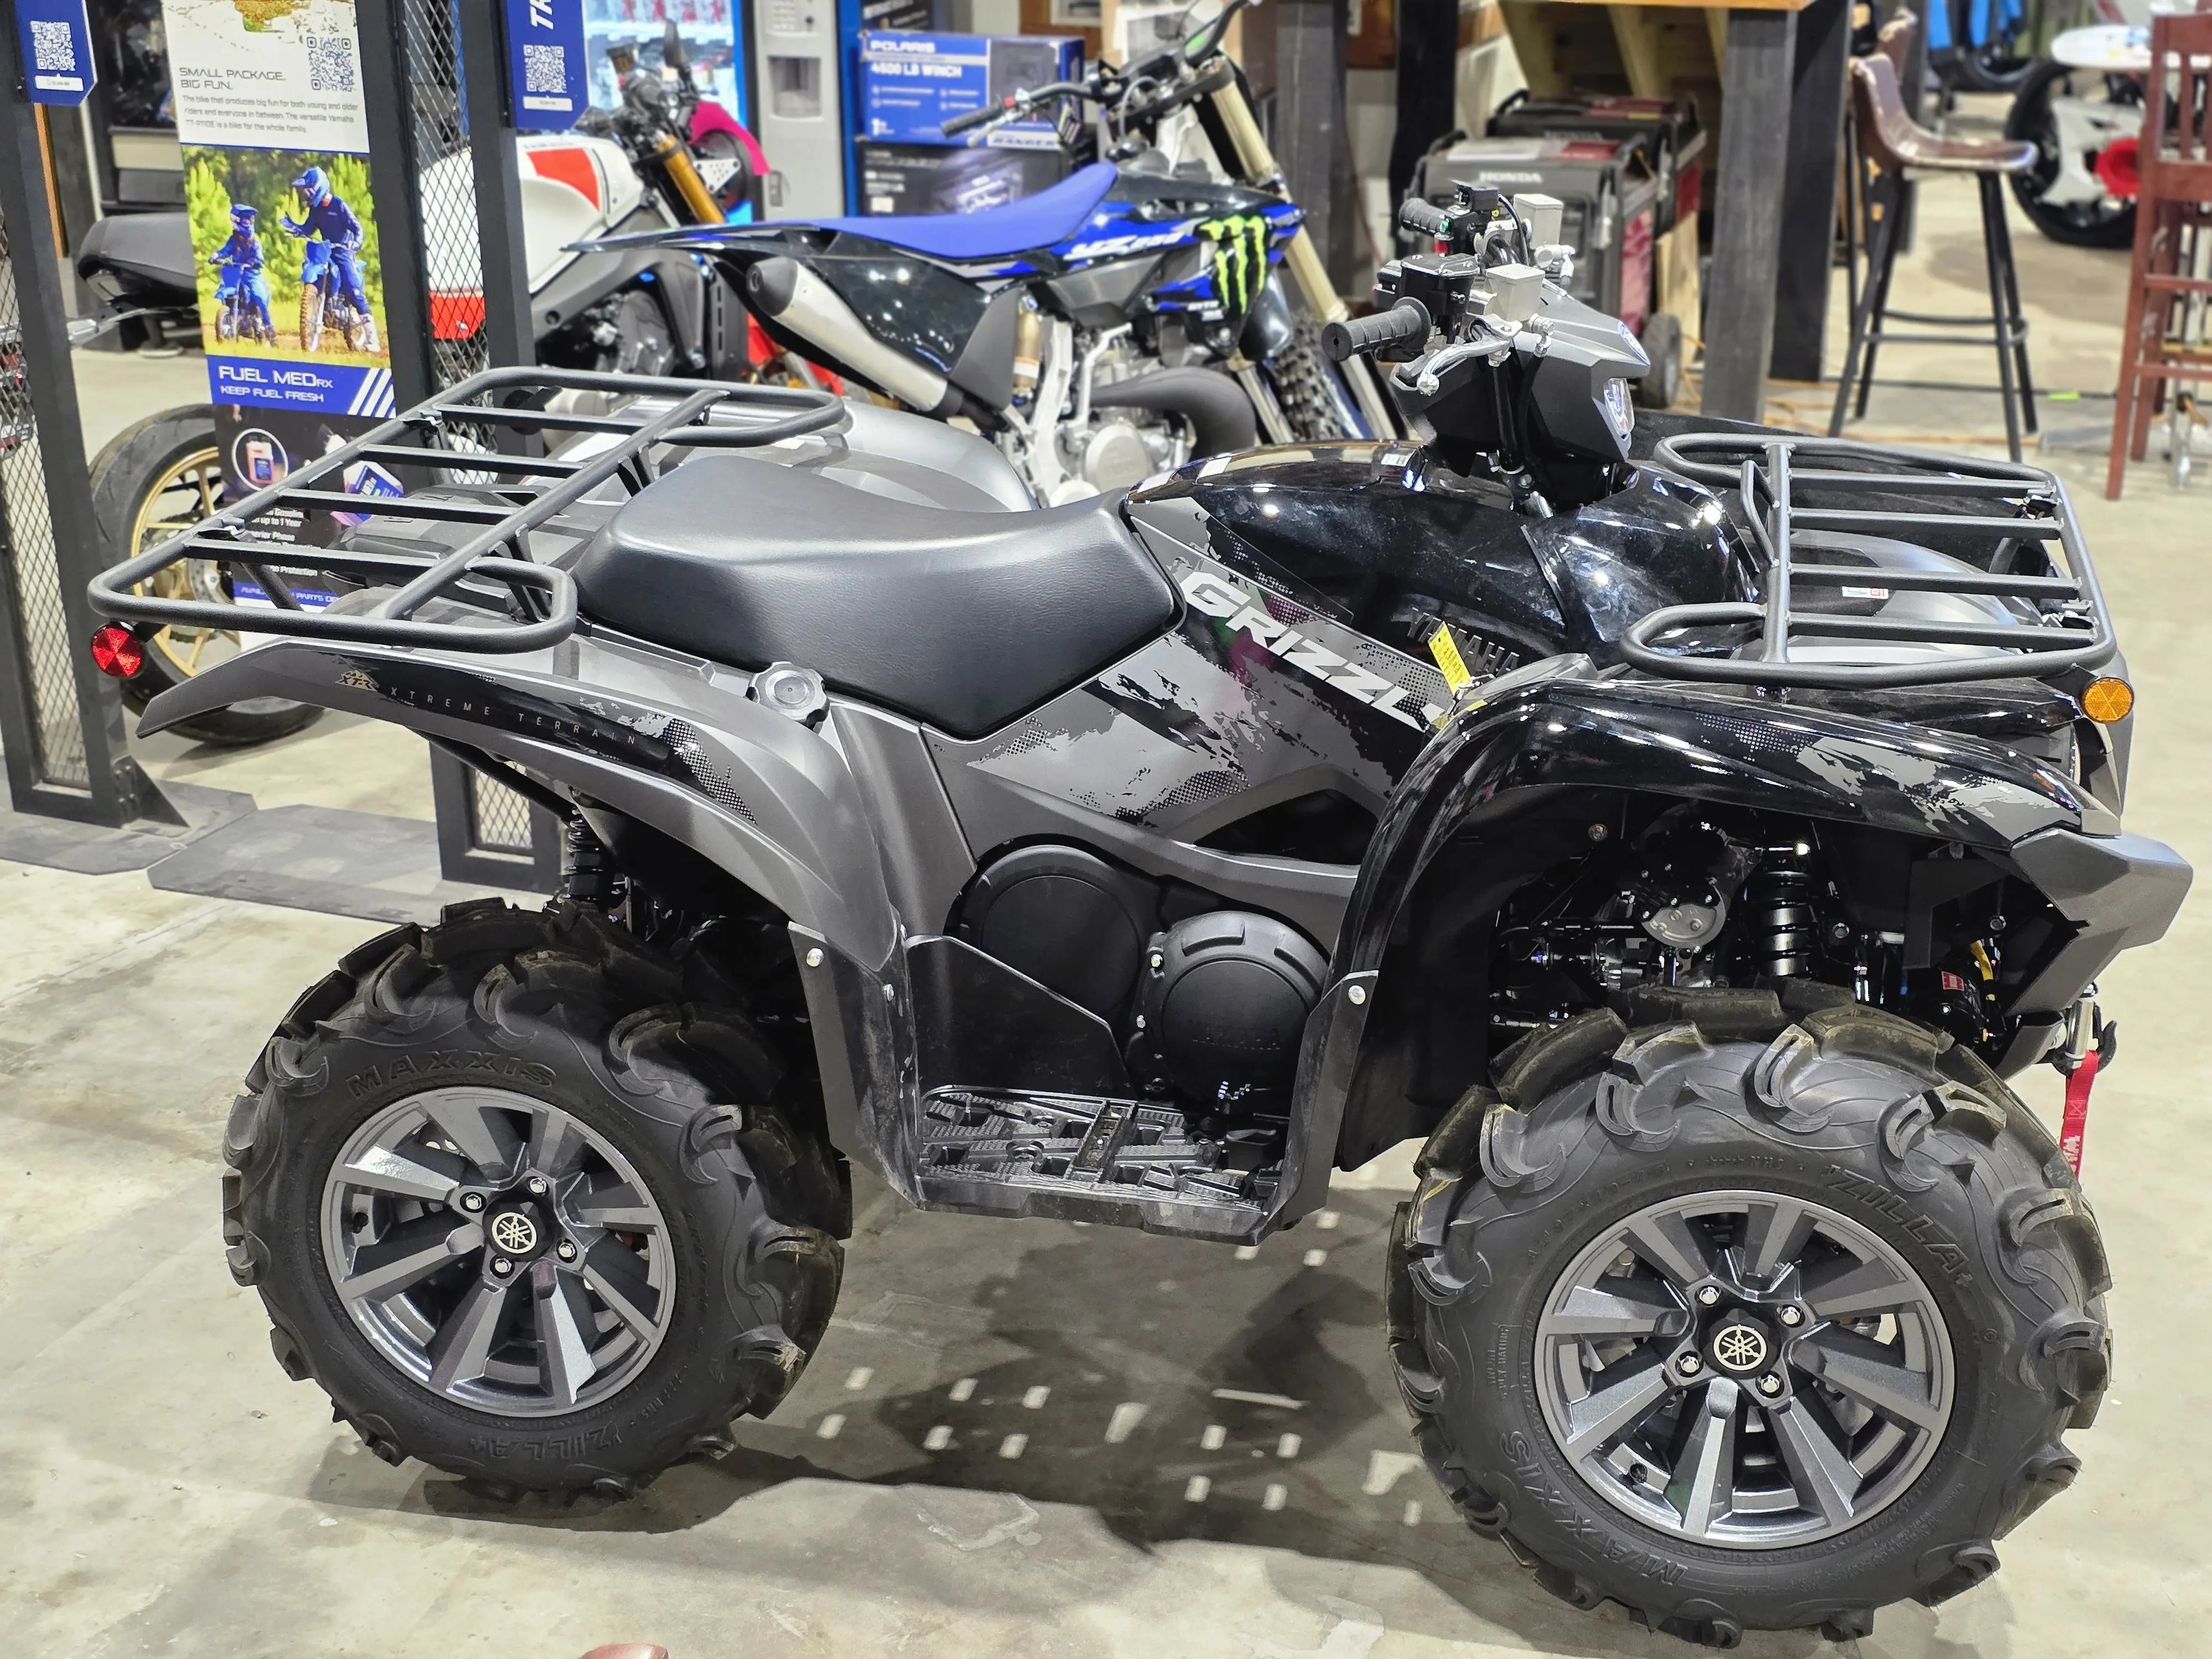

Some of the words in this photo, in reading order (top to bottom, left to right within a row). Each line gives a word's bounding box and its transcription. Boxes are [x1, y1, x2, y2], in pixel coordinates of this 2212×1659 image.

[870, 40, 936, 53] POLARIS
[179, 67, 223, 77] SMALL
[226, 69, 286, 81] PACKAGE.
[904, 64, 920, 77] LB
[922, 65, 962, 78] WINCH
[180, 79, 201, 88] BIG
[204, 80, 233, 90] FUN.
[225, 97, 255, 107] produces
[256, 98, 267, 107] big
[291, 100, 306, 108] both
[306, 102, 327, 111] young
[328, 102, 341, 110] and
[342, 102, 358, 111] older
[218, 109, 247, 118] everyone
[286, 112, 298, 120] The
[299, 112, 327, 122] versatile
[328, 114, 354, 123] Yamaha
[228, 121, 243, 129] bike
[243, 122, 253, 130] for
[254, 122, 265, 131] the
[266, 123, 285, 132] whole
[1479, 171, 1542, 182] HONDA
[218, 366, 268, 384] FUEL
[221, 385, 250, 396] KEEP
[252, 388, 283, 399] FUEL
[285, 390, 325, 403] FRESH
[285, 518, 302, 528] Year
[296, 593, 324, 602] PARTS
[1179, 571, 1445, 733] GRIZZL
[390, 686, 491, 716] XTREME
[518, 712, 636, 745] TERRAIN
[345, 1048, 558, 1100] MAXXIS
[1499, 1431, 1689, 1587] MAXXIS
